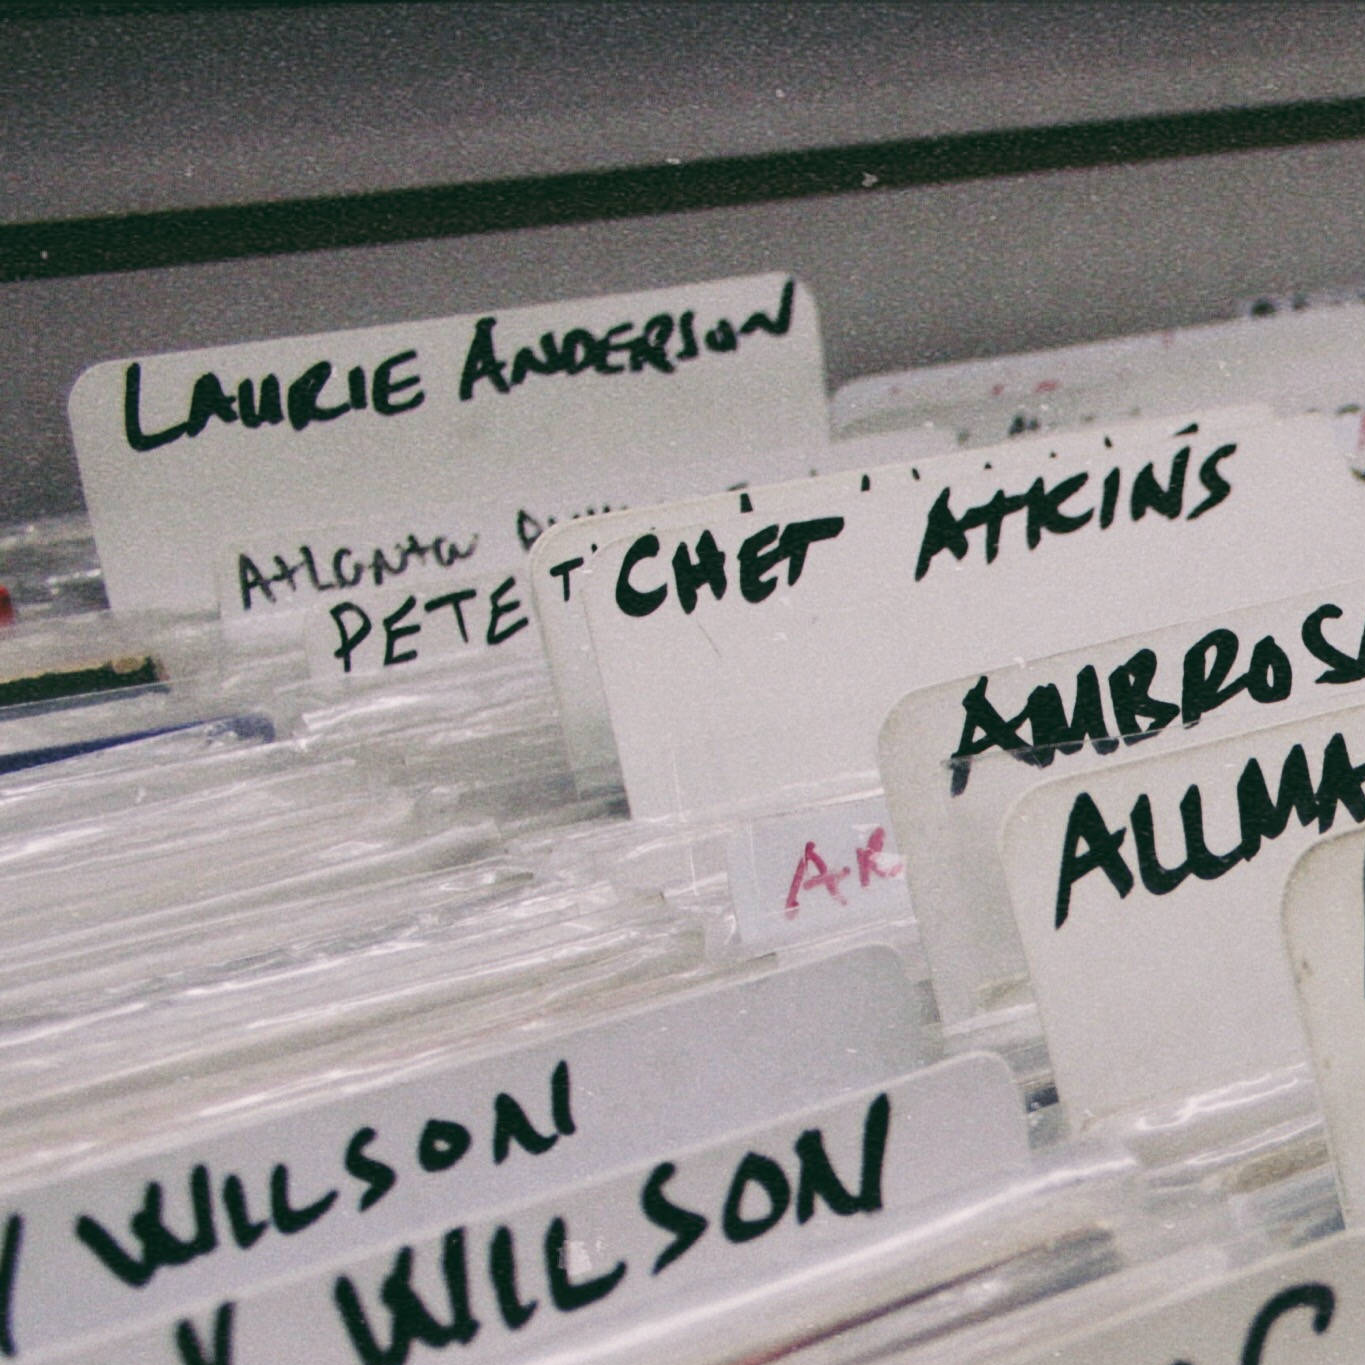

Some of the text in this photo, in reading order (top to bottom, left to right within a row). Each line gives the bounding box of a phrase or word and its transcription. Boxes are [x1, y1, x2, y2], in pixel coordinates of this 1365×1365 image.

[124, 279, 795, 452] LAURIE ANDERSON
[614, 516, 844, 618] CHET
[914, 442, 1237, 582] ATKINS
[329, 576, 530, 672] PETE
[76, 1058, 576, 1289] WILSON
